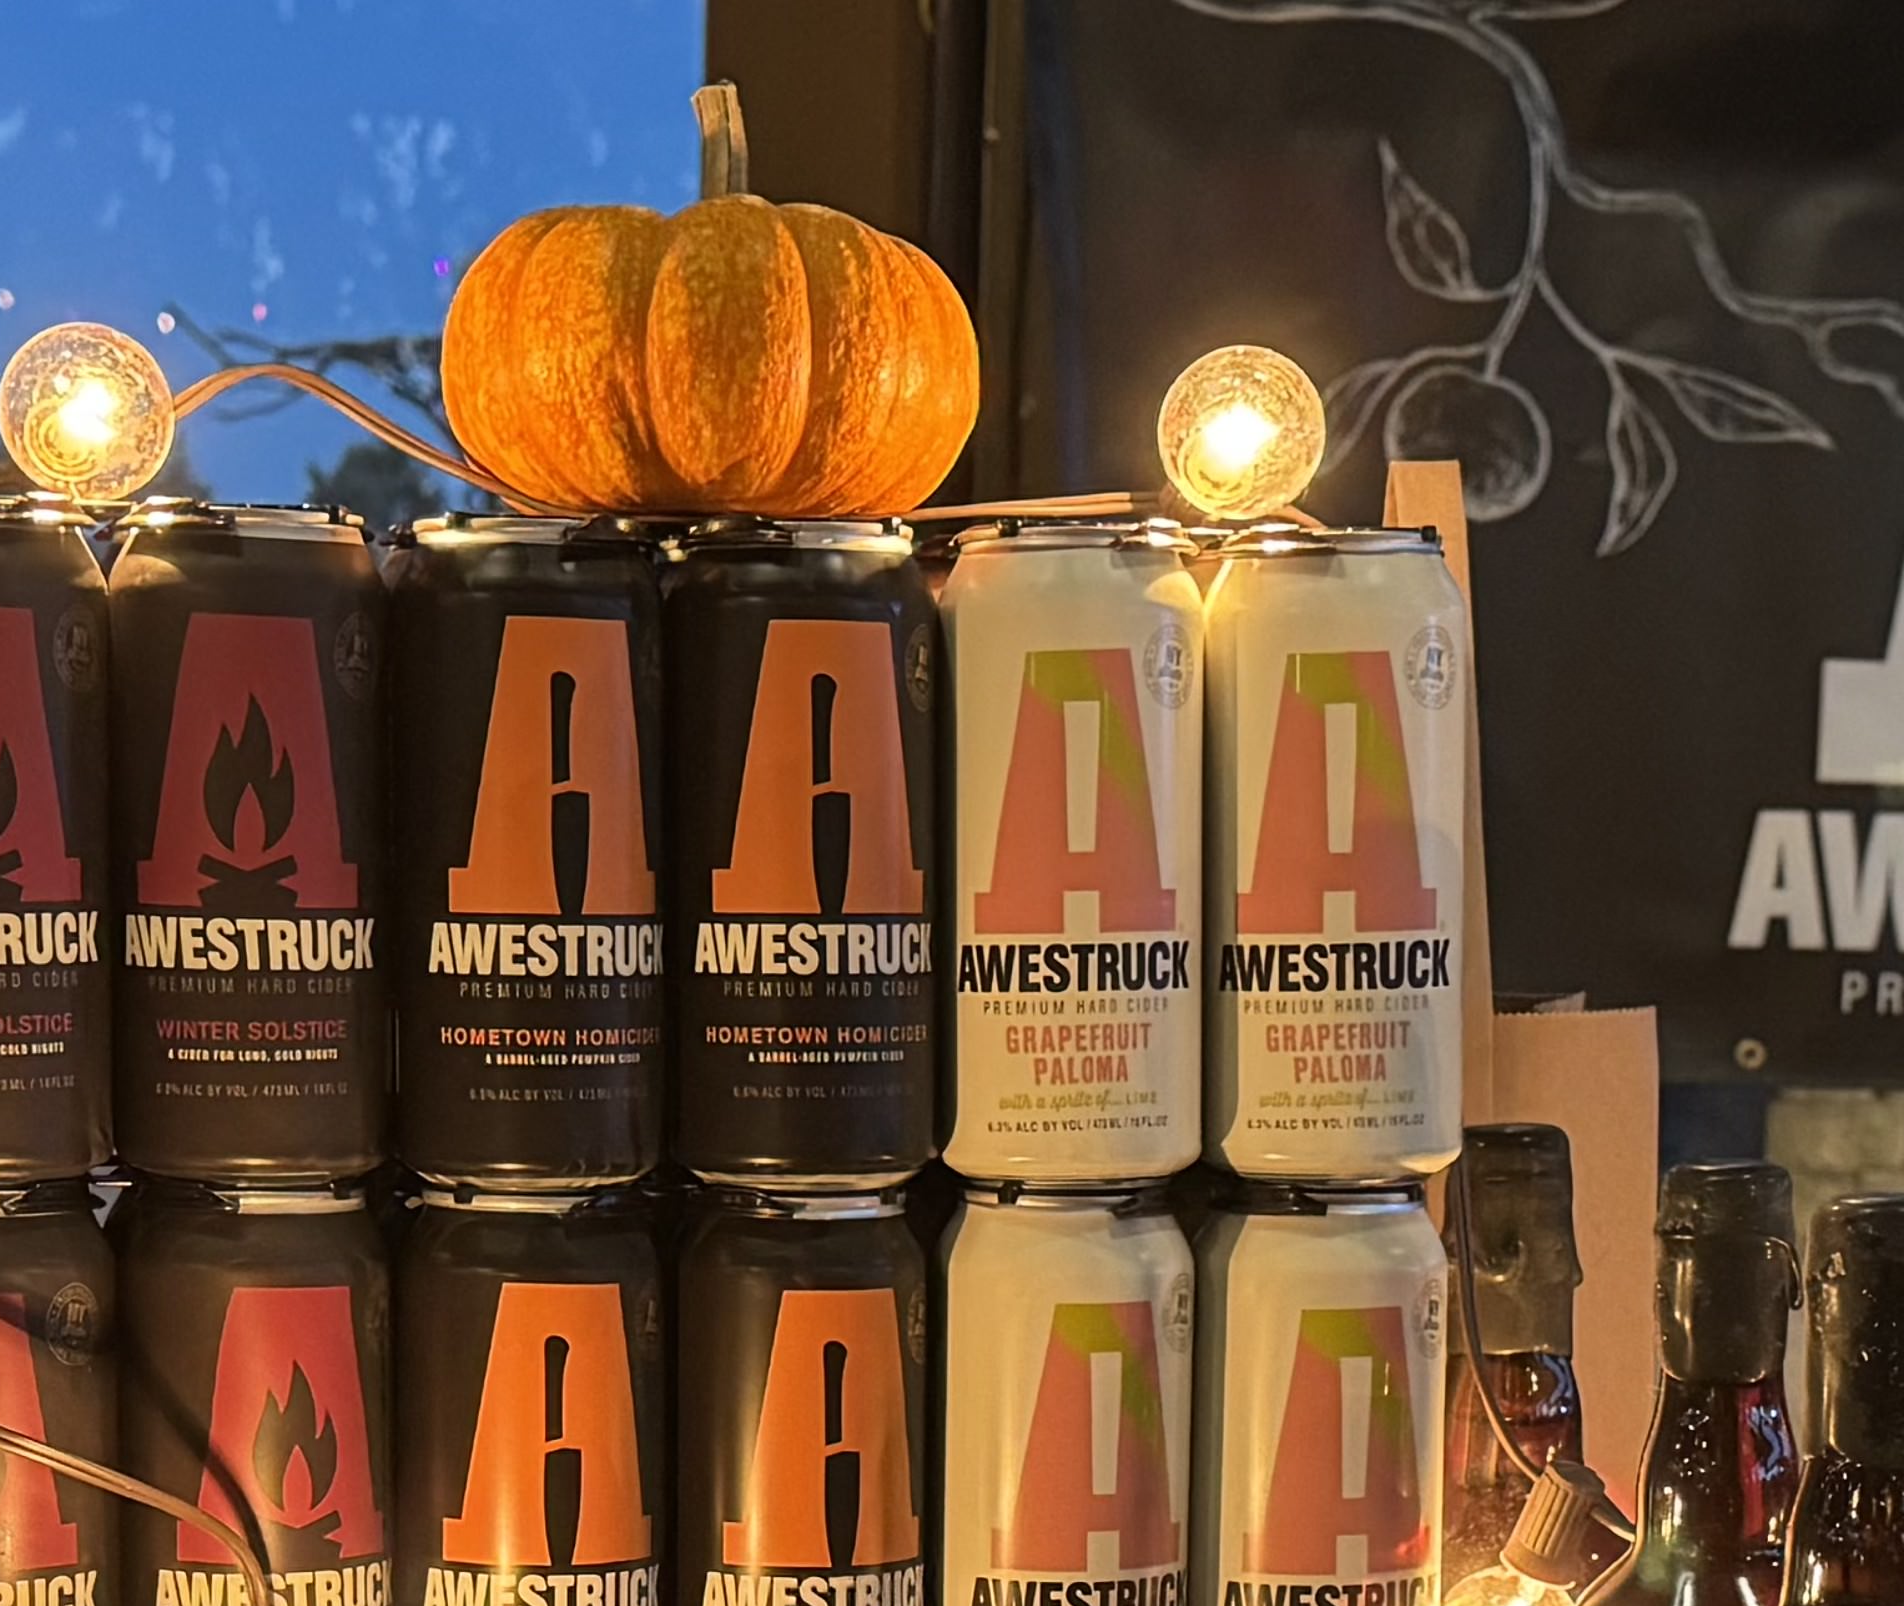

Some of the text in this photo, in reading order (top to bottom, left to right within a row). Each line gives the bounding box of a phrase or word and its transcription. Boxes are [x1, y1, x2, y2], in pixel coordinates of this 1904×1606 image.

[125, 914, 374, 971] AWESTRUCK
[429, 922, 664, 977] AWESTRUCK
[695, 923, 932, 975] AWESTRUCK
[33, 970, 78, 987] CIDER
[958, 941, 1189, 993] AWESTRUCK
[1219, 939, 1449, 992] AWESTRUCK
[460, 982, 609, 998] PREMIUM HARD
[1244, 995, 1429, 1014] PREMIUM HARD CIDER
[984, 997, 1168, 1015] PREMIUM HARD CIDER
[157, 1020, 346, 1040] WINTER SOLSTICE
[441, 1027, 566, 1045] HOMETOWN
[706, 1025, 927, 1044] HOMETOWN HOMICIDER
[1007, 1022, 1152, 1053] GRAPEFRUIT
[1266, 1021, 1411, 1052] GRAPEFRUIT
[1034, 1056, 1129, 1085] PALOMA
[1294, 1054, 1386, 1084] PALOMA
